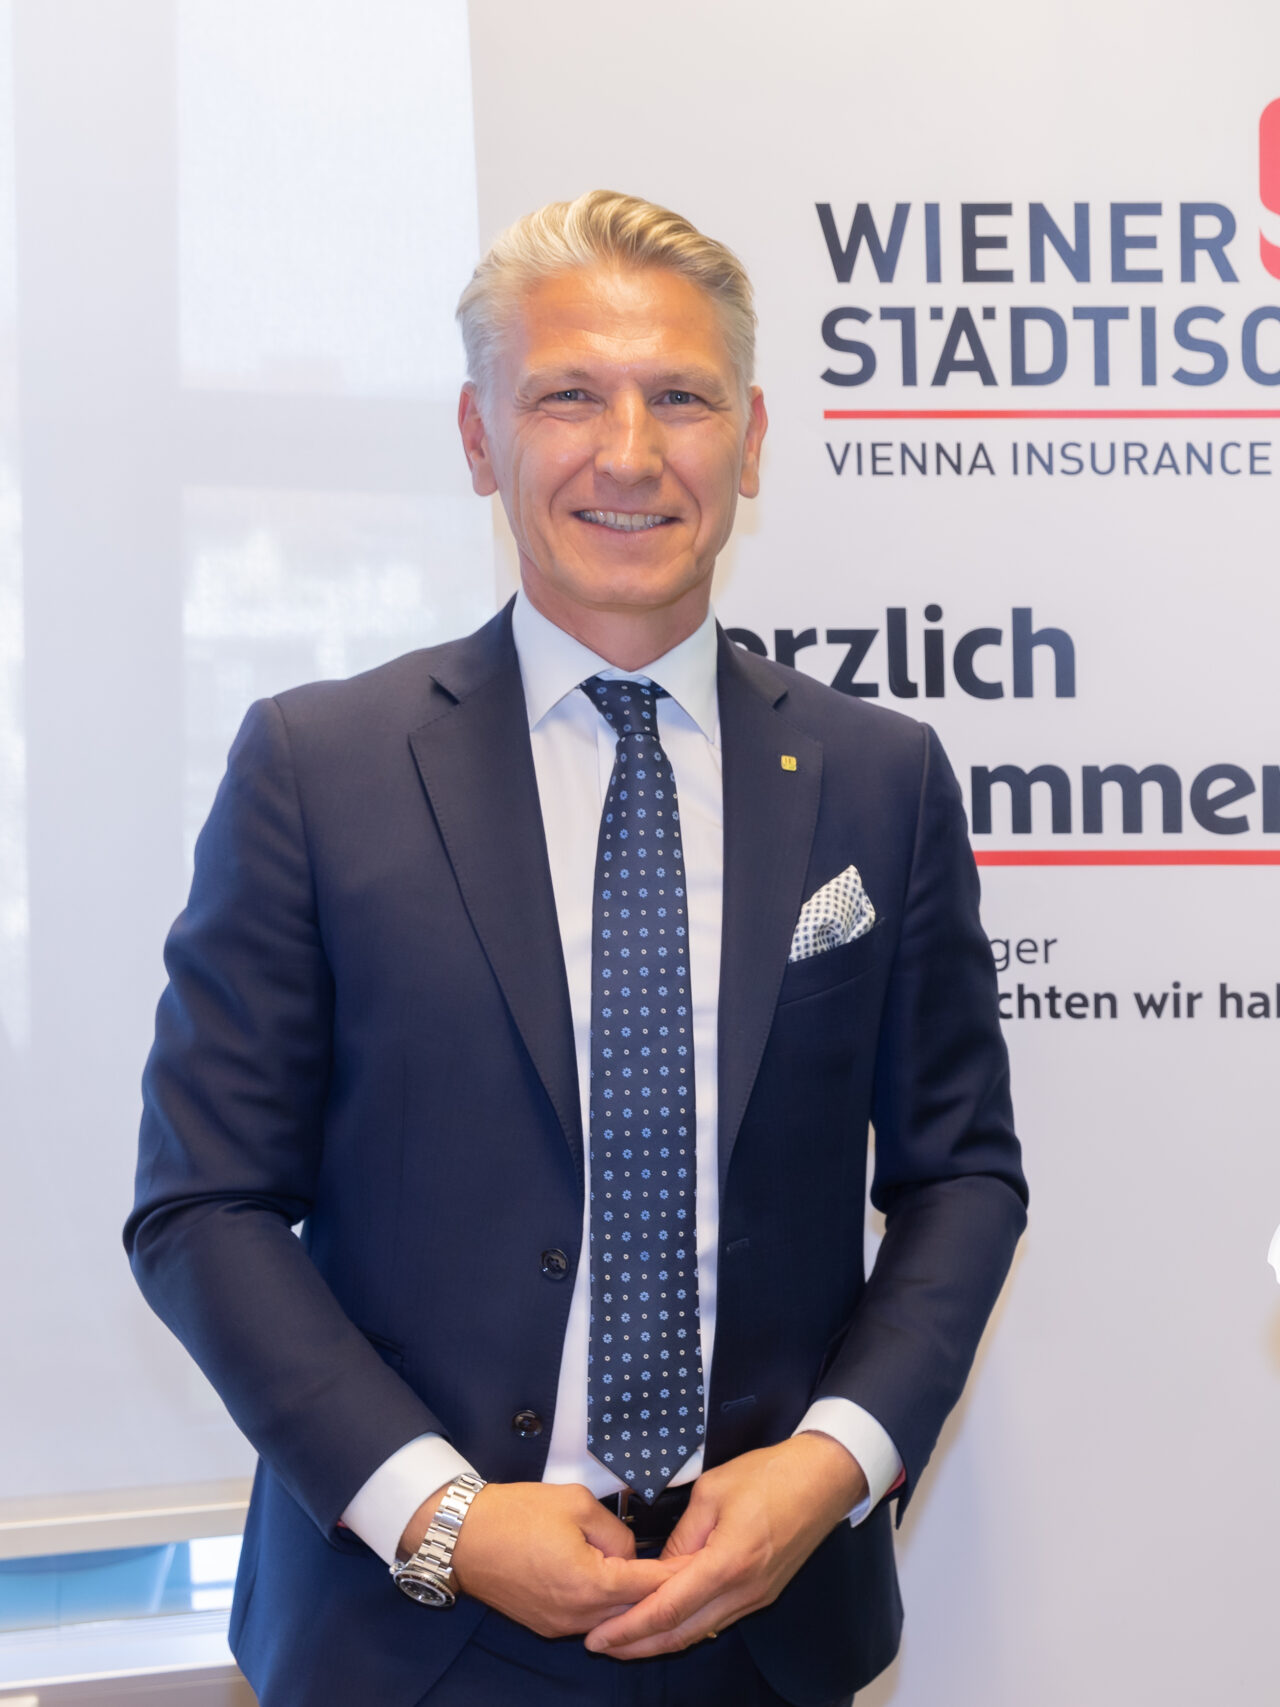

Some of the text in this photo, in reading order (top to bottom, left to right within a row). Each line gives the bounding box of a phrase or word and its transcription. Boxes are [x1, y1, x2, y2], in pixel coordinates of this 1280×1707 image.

[815, 202, 1240, 284] WIENER
[825, 442, 996, 477] VIENNA
[1012, 441, 1272, 476] INSURANCE
[1133, 980, 1204, 1020] wir
